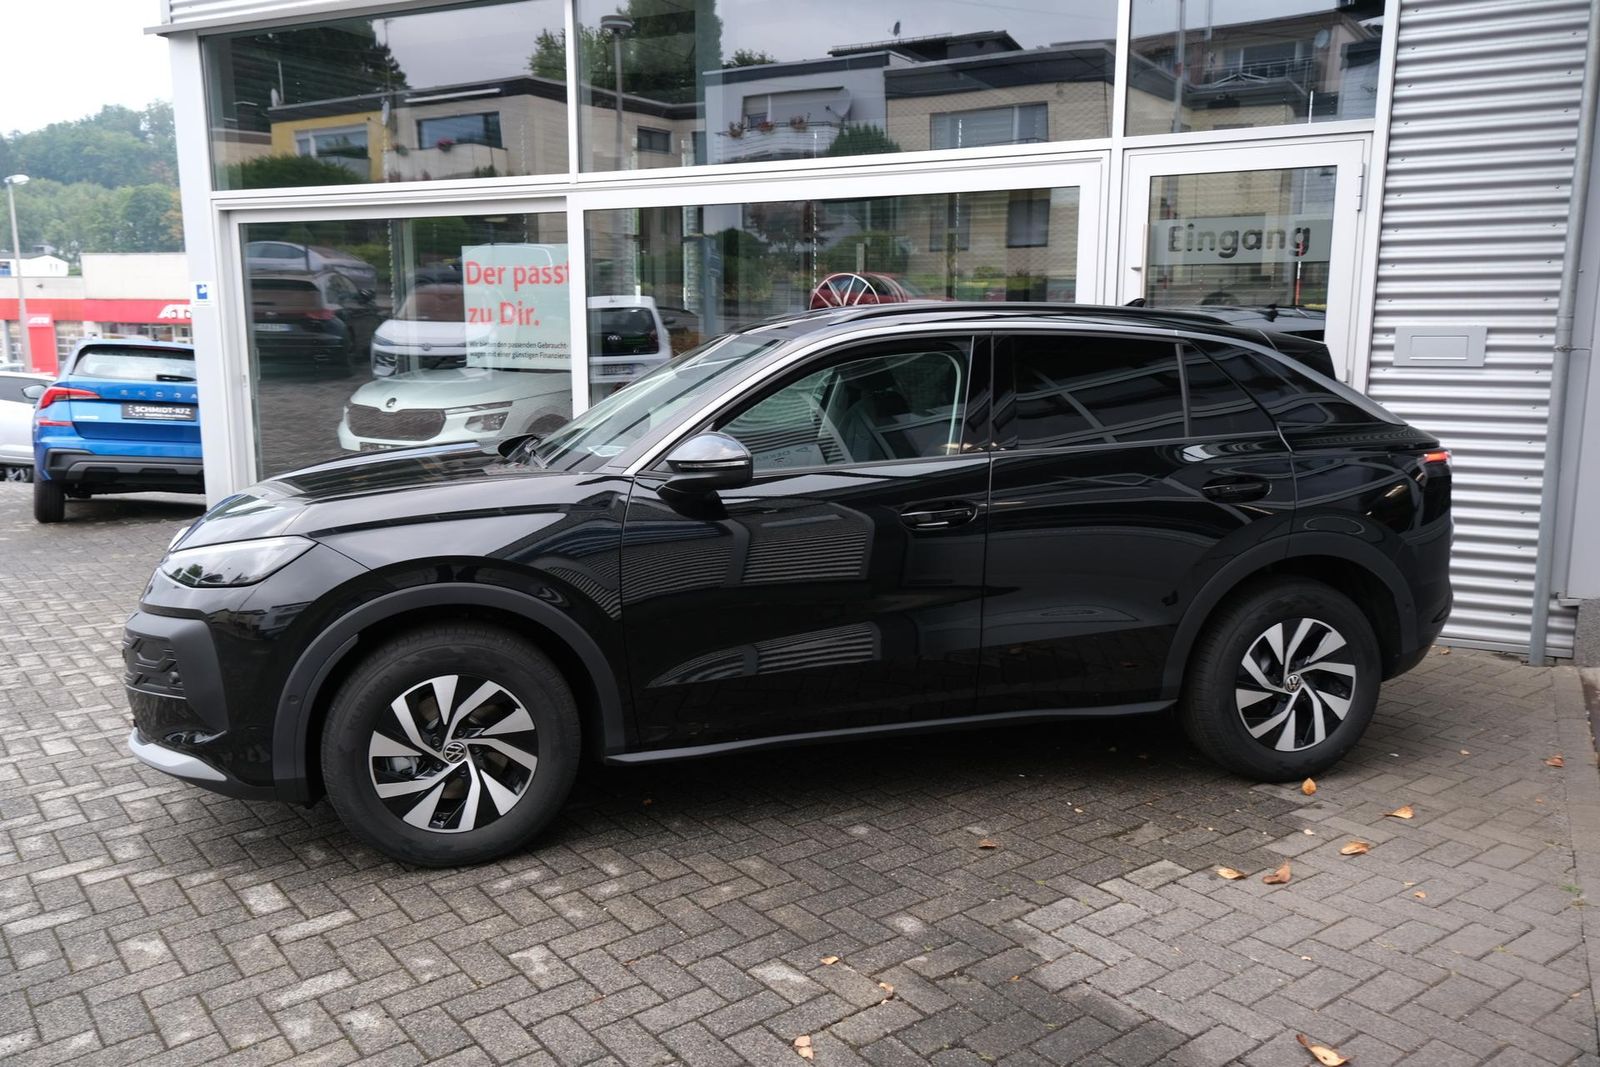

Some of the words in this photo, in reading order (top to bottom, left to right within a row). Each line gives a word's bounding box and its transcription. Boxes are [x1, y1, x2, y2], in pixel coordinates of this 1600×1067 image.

[1168, 223, 1311, 259] Eingang
[465, 261, 506, 285] Der
[467, 308, 493, 324] zu
[499, 300, 541, 326] Dir.
